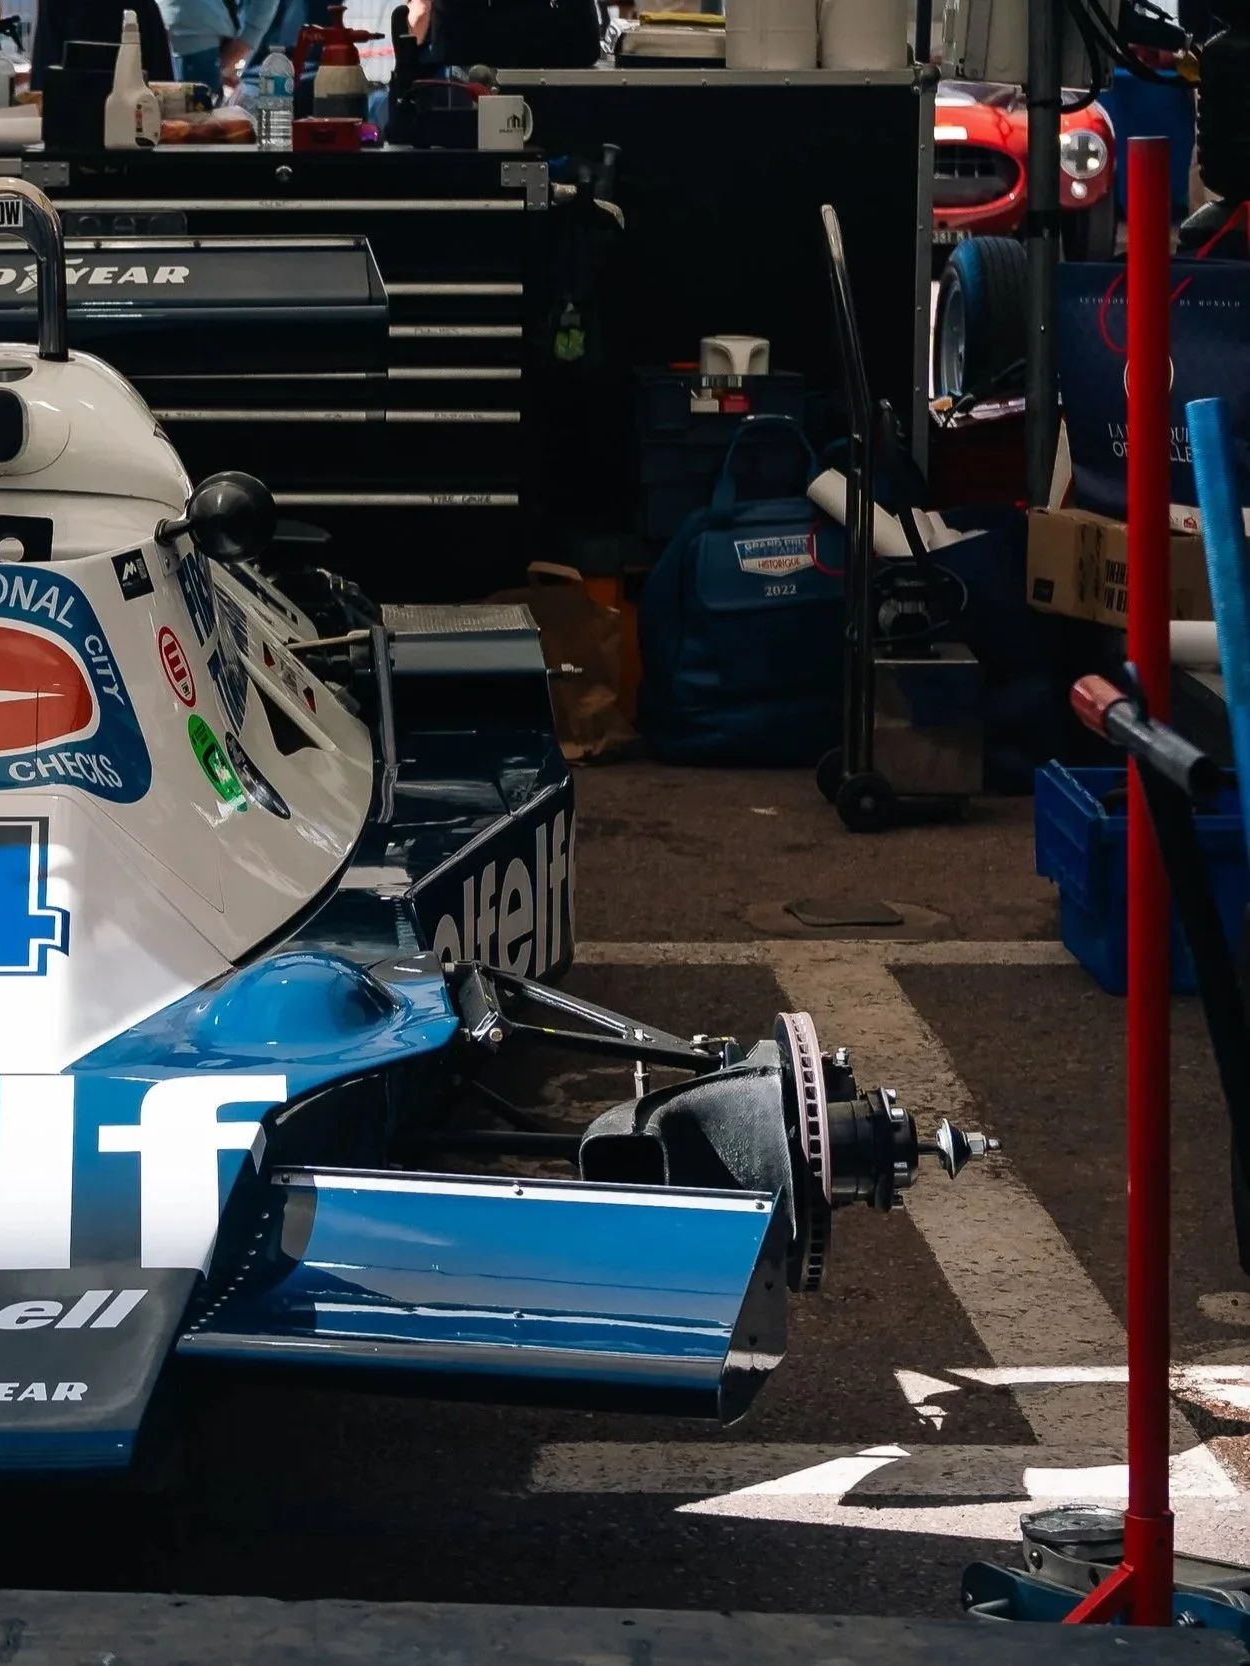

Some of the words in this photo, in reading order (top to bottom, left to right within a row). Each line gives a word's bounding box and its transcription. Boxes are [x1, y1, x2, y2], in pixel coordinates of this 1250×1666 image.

[765, 584, 798, 598] 2022
[84, 634, 126, 706] CITY
[7, 751, 124, 789] CHECKS
